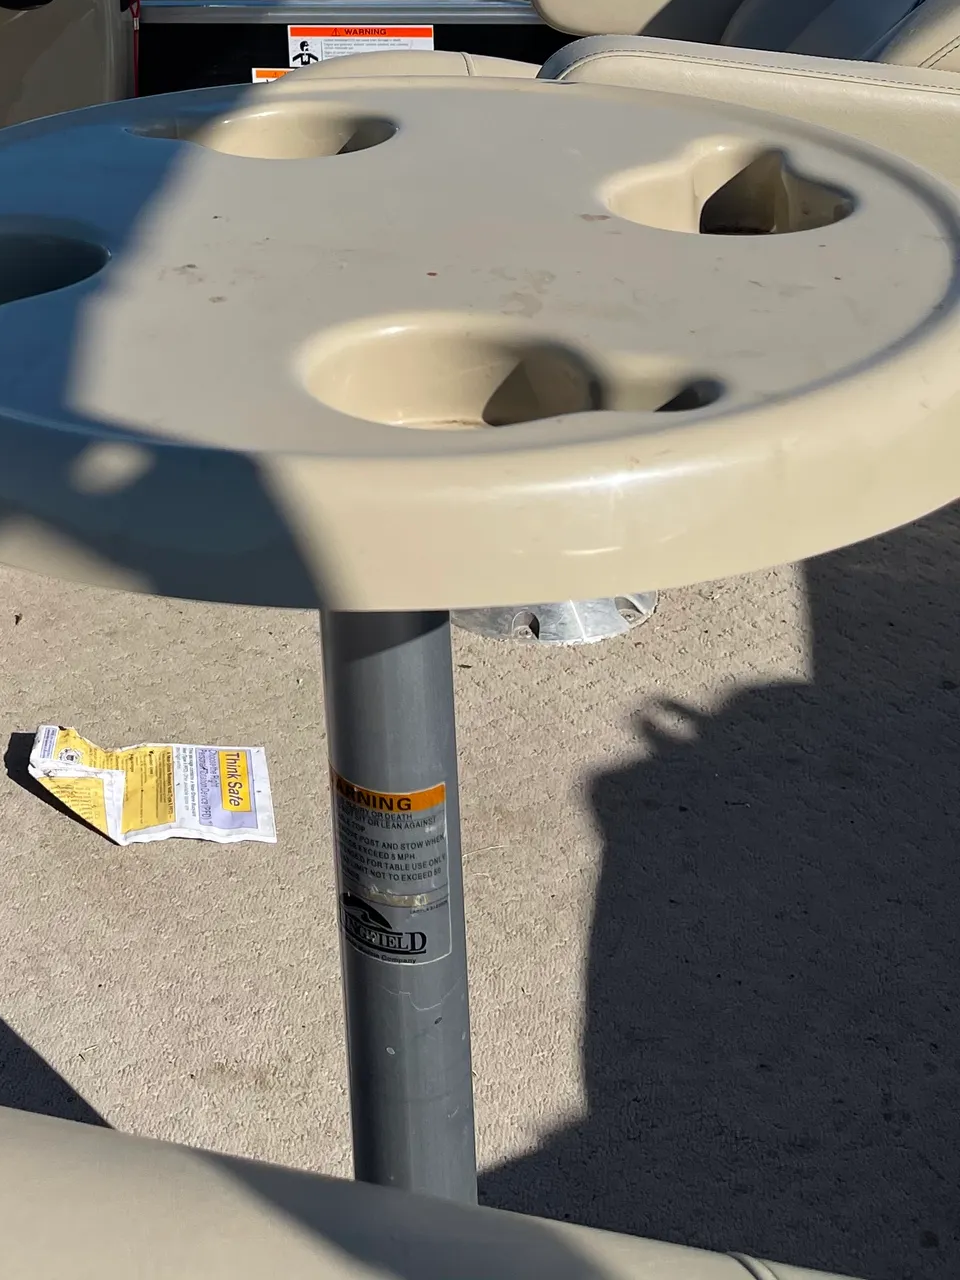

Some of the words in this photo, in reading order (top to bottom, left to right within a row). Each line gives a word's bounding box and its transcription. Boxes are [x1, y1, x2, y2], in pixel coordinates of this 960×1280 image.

[344, 28, 387, 36] WARNING
[225, 752, 241, 780] Think
[208, 775, 219, 788] Right
[227, 781, 243, 807] Safe
[337, 782, 412, 812] ARNING
[381, 821, 403, 830] LEAN
[404, 815, 437, 830] AGAINST
[384, 812, 413, 821] DEATH
[359, 835, 380, 847] POST
[381, 841, 399, 851] AND
[400, 840, 424, 851] STOW
[424, 834, 445, 847] WHEN
[358, 844, 390, 860] EXCEED
[366, 858, 383, 869] FOR
[384, 862, 410, 871] TABLE
[411, 861, 427, 871] USE
[428, 854, 446, 867] ONLY
[370, 868, 386, 880] NOT
[388, 873, 400, 881] TO
[401, 870, 433, 881] EXCEED
[381, 954, 417, 964] Company
